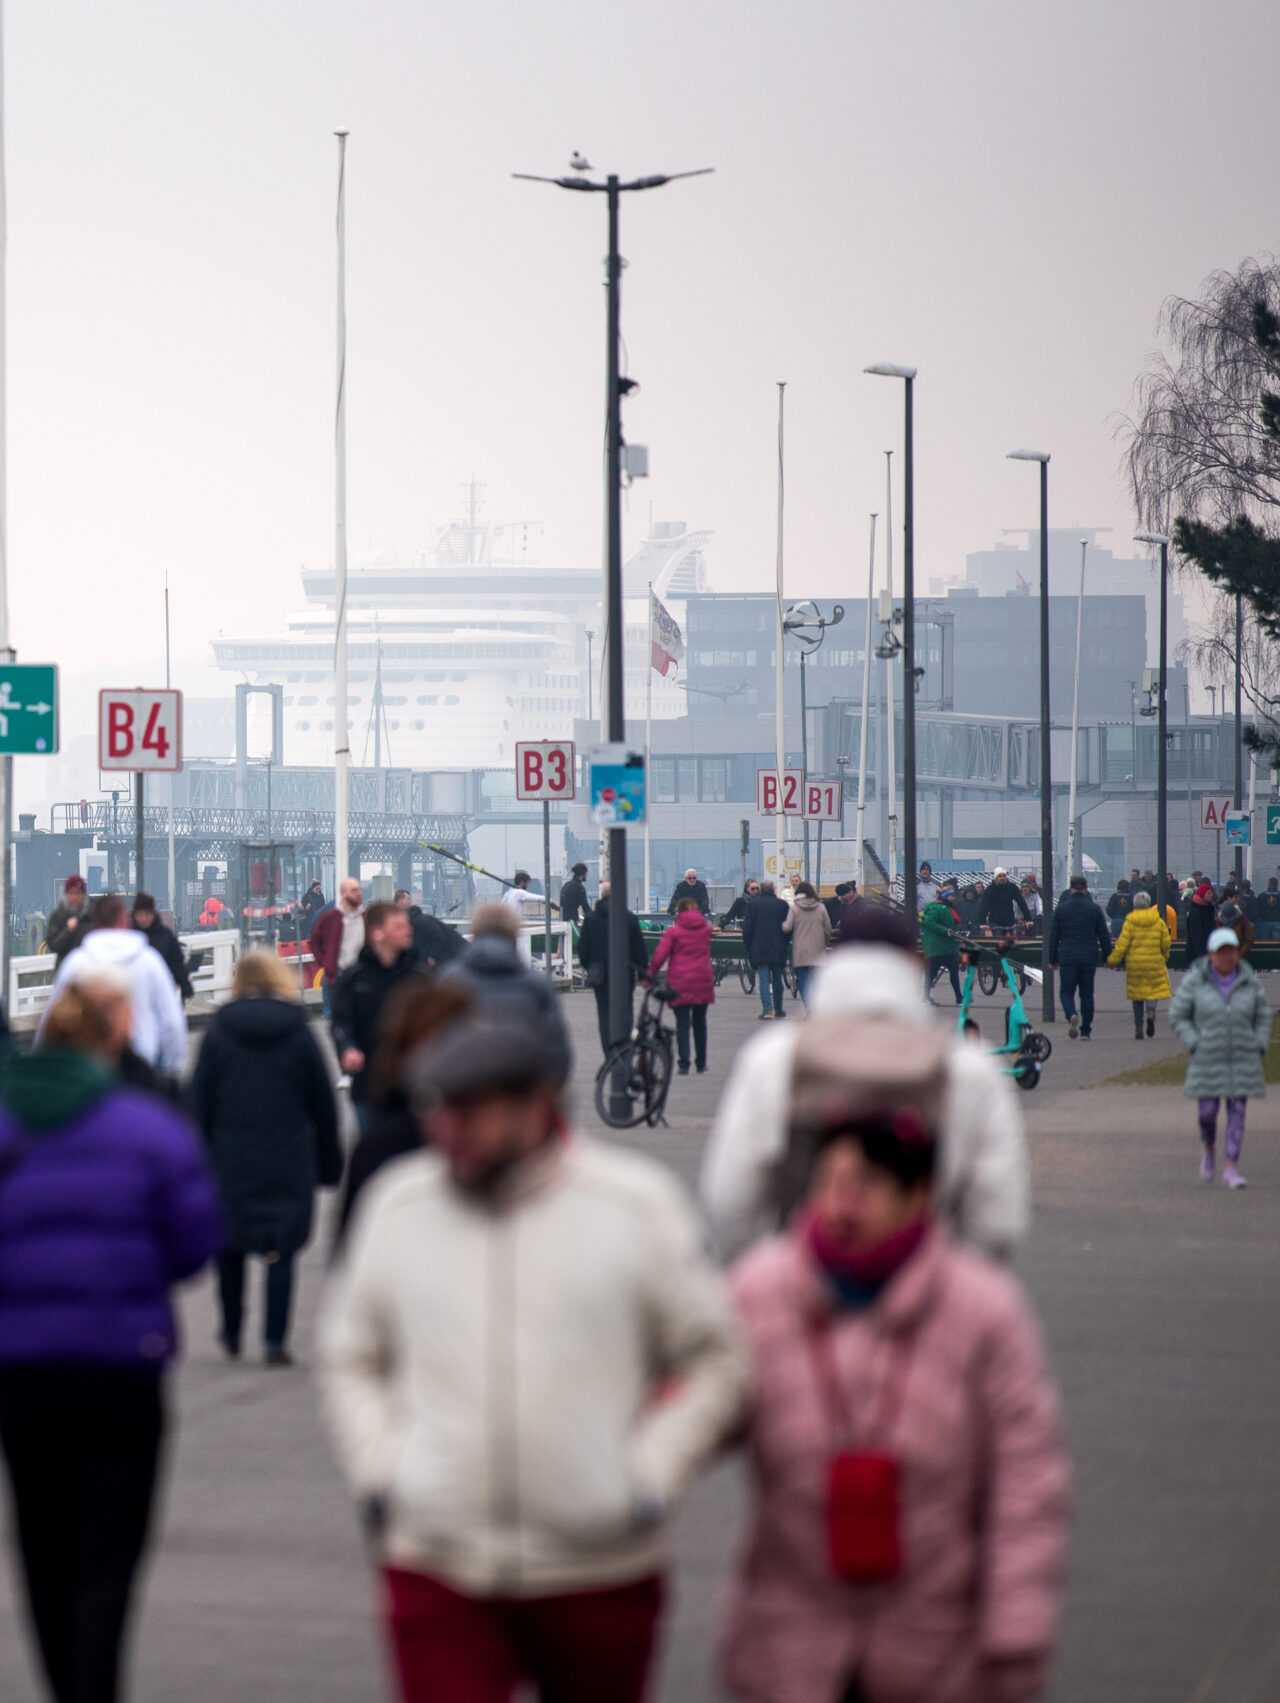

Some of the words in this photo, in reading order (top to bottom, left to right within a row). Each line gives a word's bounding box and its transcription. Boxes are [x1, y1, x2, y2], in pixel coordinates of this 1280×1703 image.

[108, 702, 169, 758] B4
[524, 750, 566, 792] B3
[763, 775, 797, 809] B2
[808, 787, 833, 815] B1
